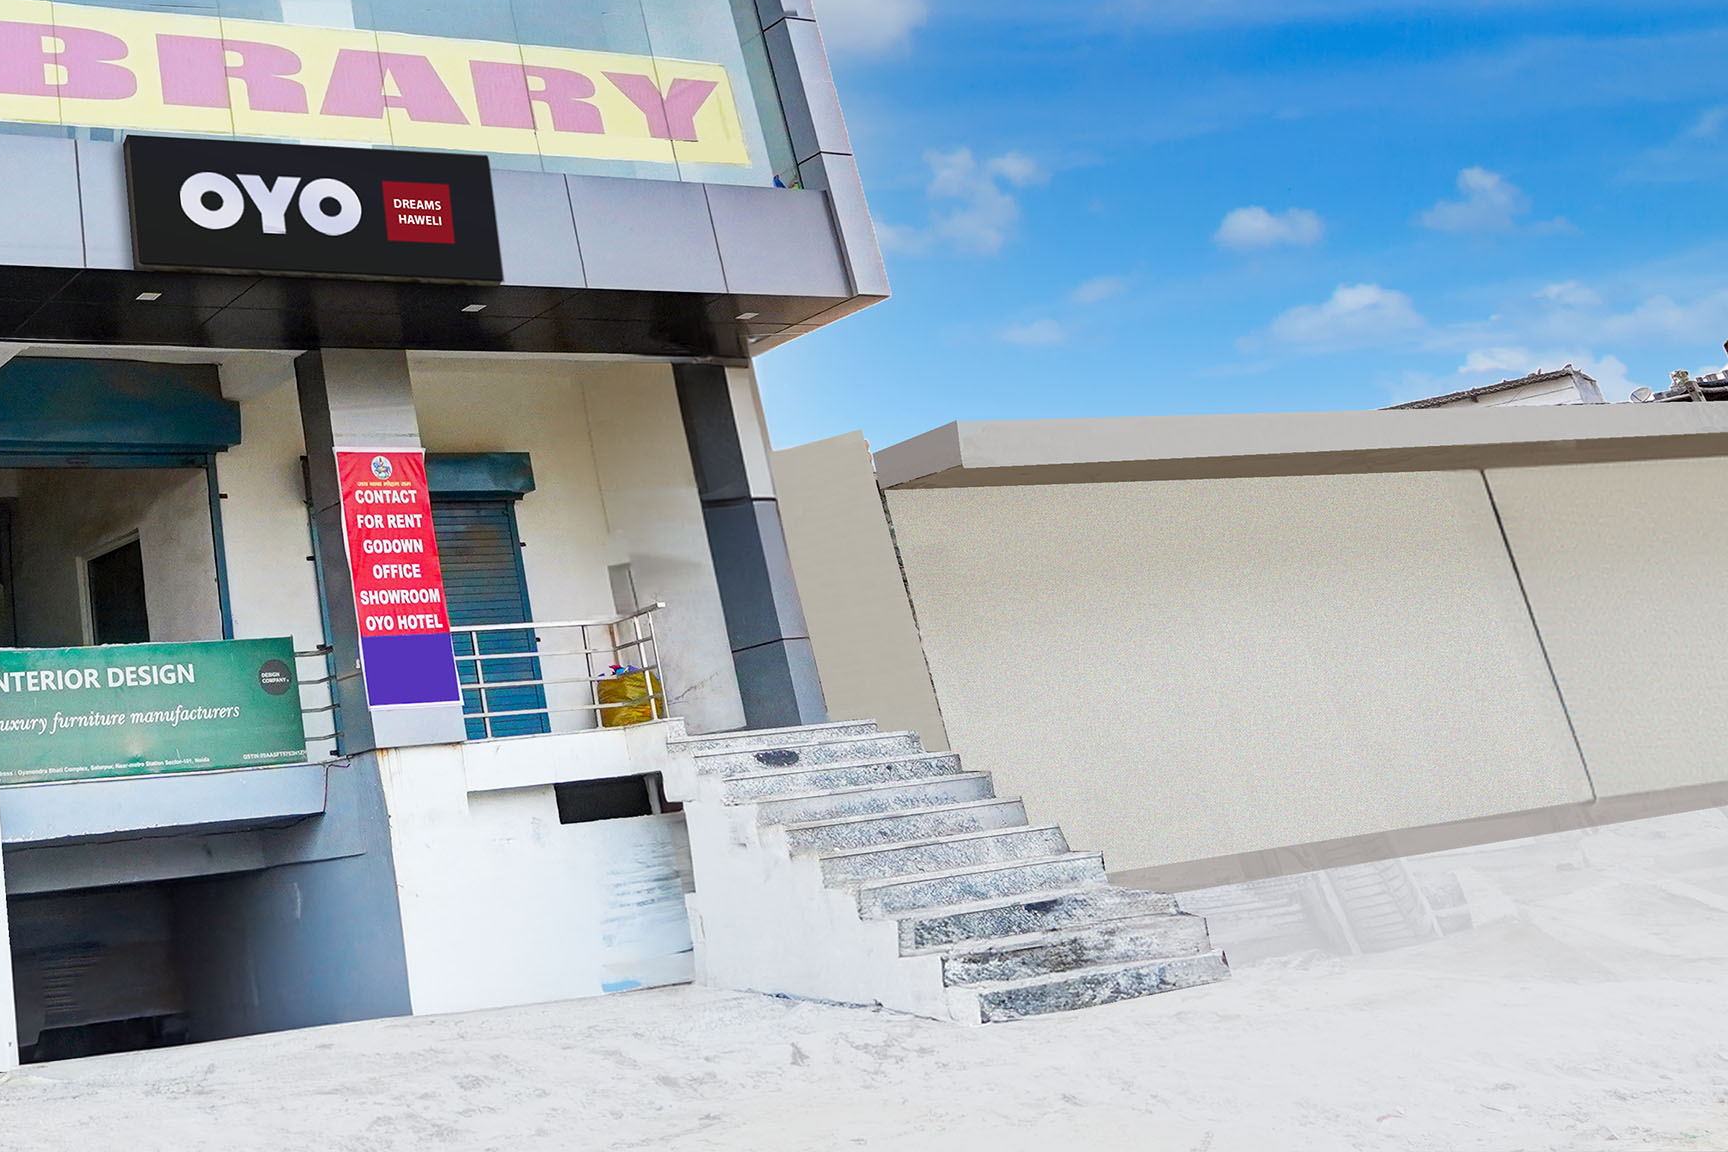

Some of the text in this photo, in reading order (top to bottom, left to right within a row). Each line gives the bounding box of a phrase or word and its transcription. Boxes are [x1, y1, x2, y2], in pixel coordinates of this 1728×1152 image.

[179, 171, 363, 237] OYO
[393, 198, 442, 211] DREAMS
[398, 213, 443, 226] HAWELI
[355, 489, 417, 504] CONTACT
[356, 513, 422, 529] FOR RENT
[363, 538, 423, 554] GODOWN
[372, 563, 422, 579] OFFICE
[360, 588, 441, 605] SHOWROOM
[365, 614, 443, 631] OYO HOTEL
[107, 663, 196, 688] DESIGN
[49, 709, 126, 735] furniture
[130, 704, 241, 727] manufacturers
